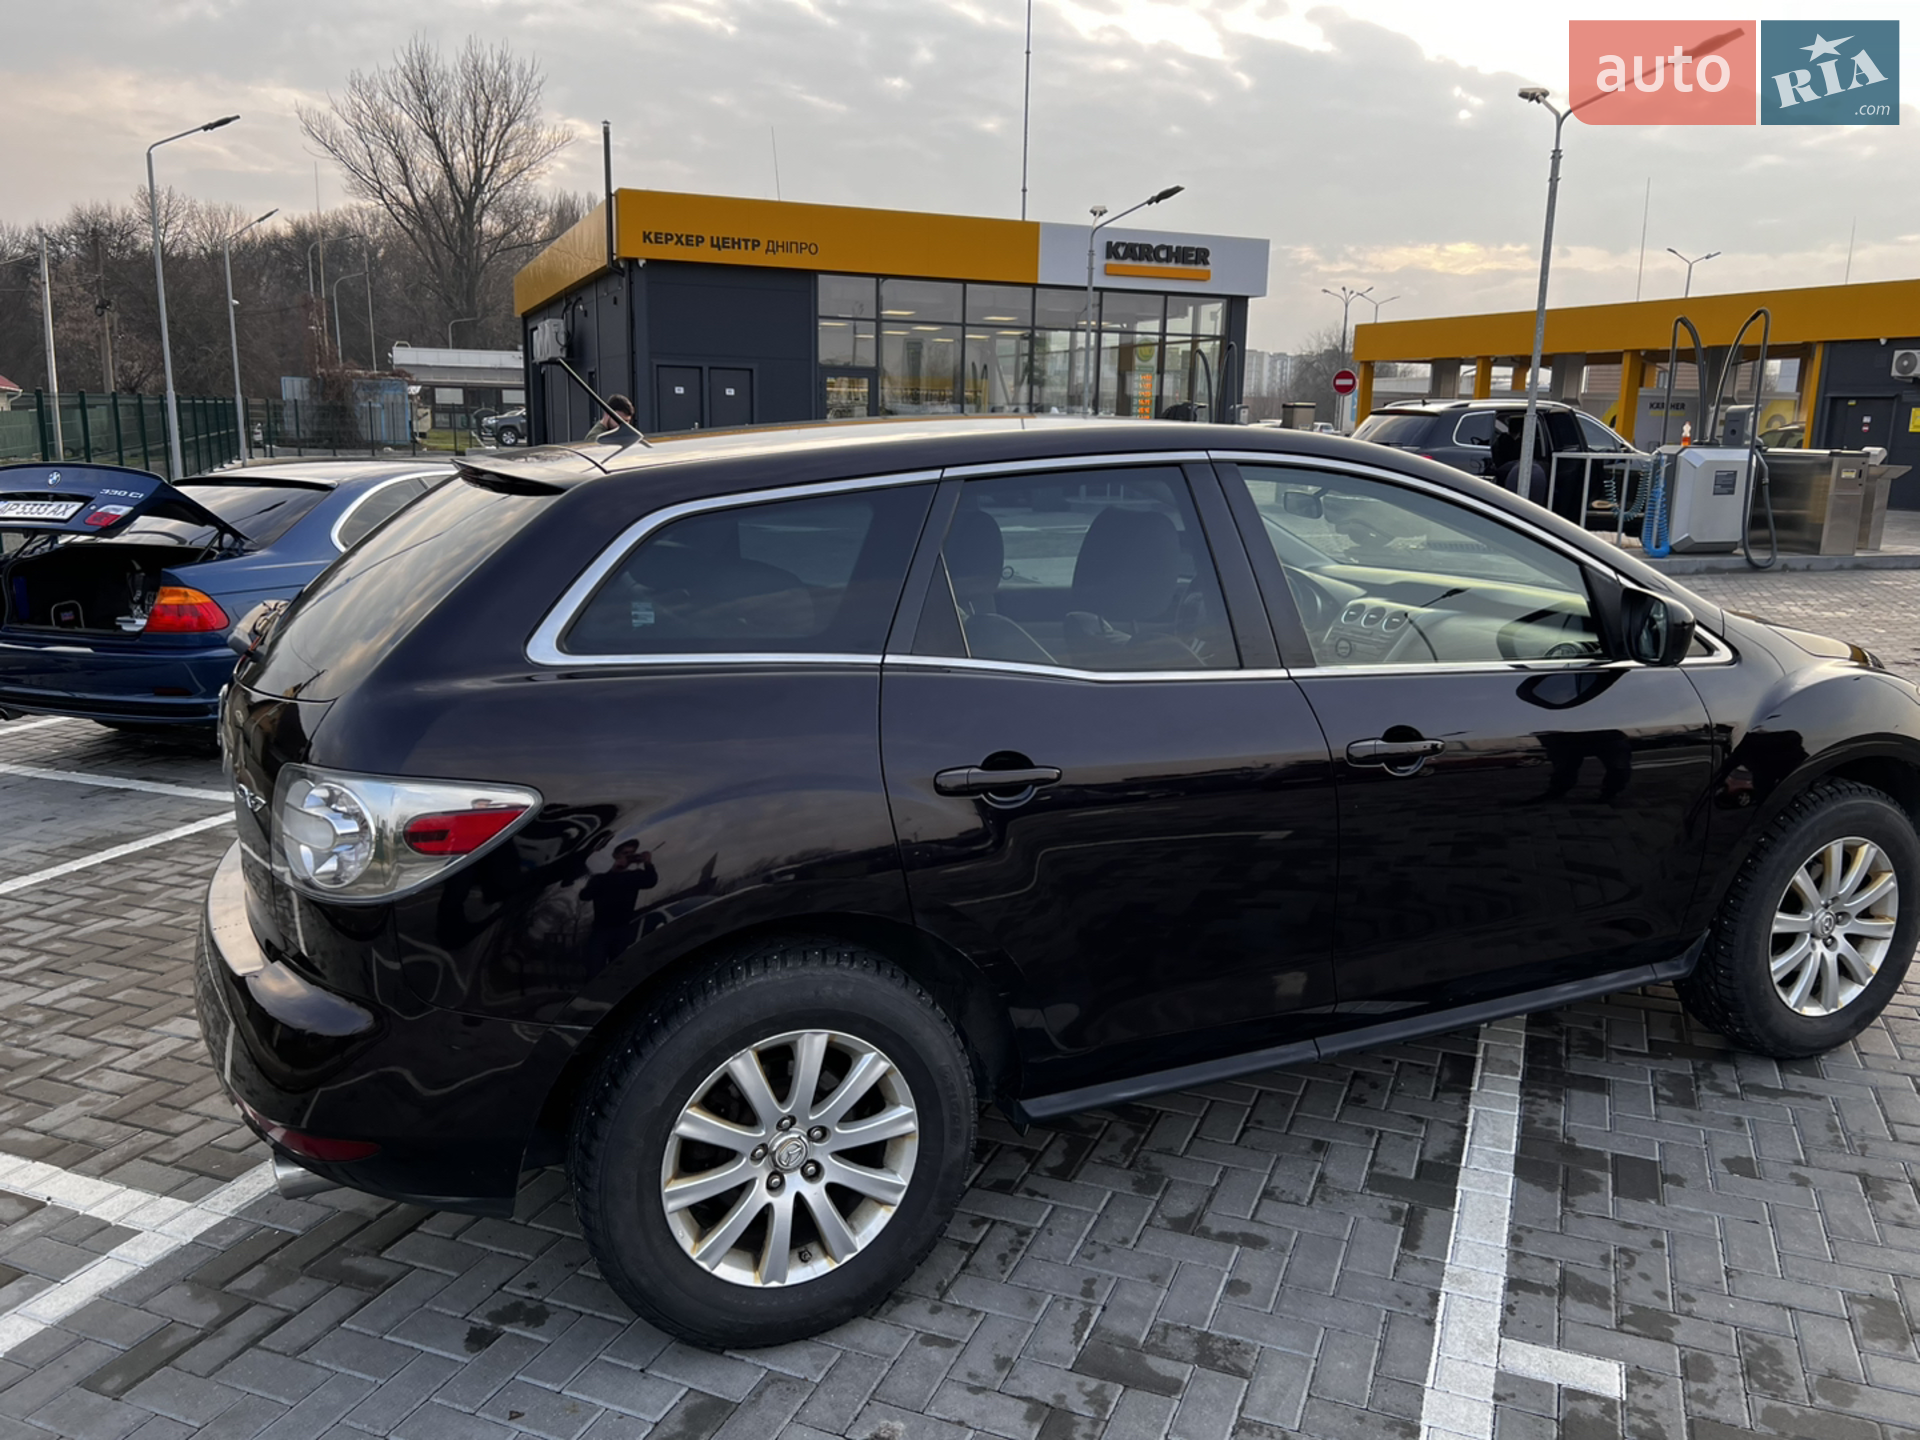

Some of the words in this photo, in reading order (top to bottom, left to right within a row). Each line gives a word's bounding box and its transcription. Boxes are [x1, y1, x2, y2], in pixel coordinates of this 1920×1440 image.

[642, 230, 705, 247] КЕРХЕР
[710, 235, 761, 251] ЦЕНТР
[765, 239, 819, 255] ДНІПРО
[1105, 240, 1211, 266] KÄRCHER
